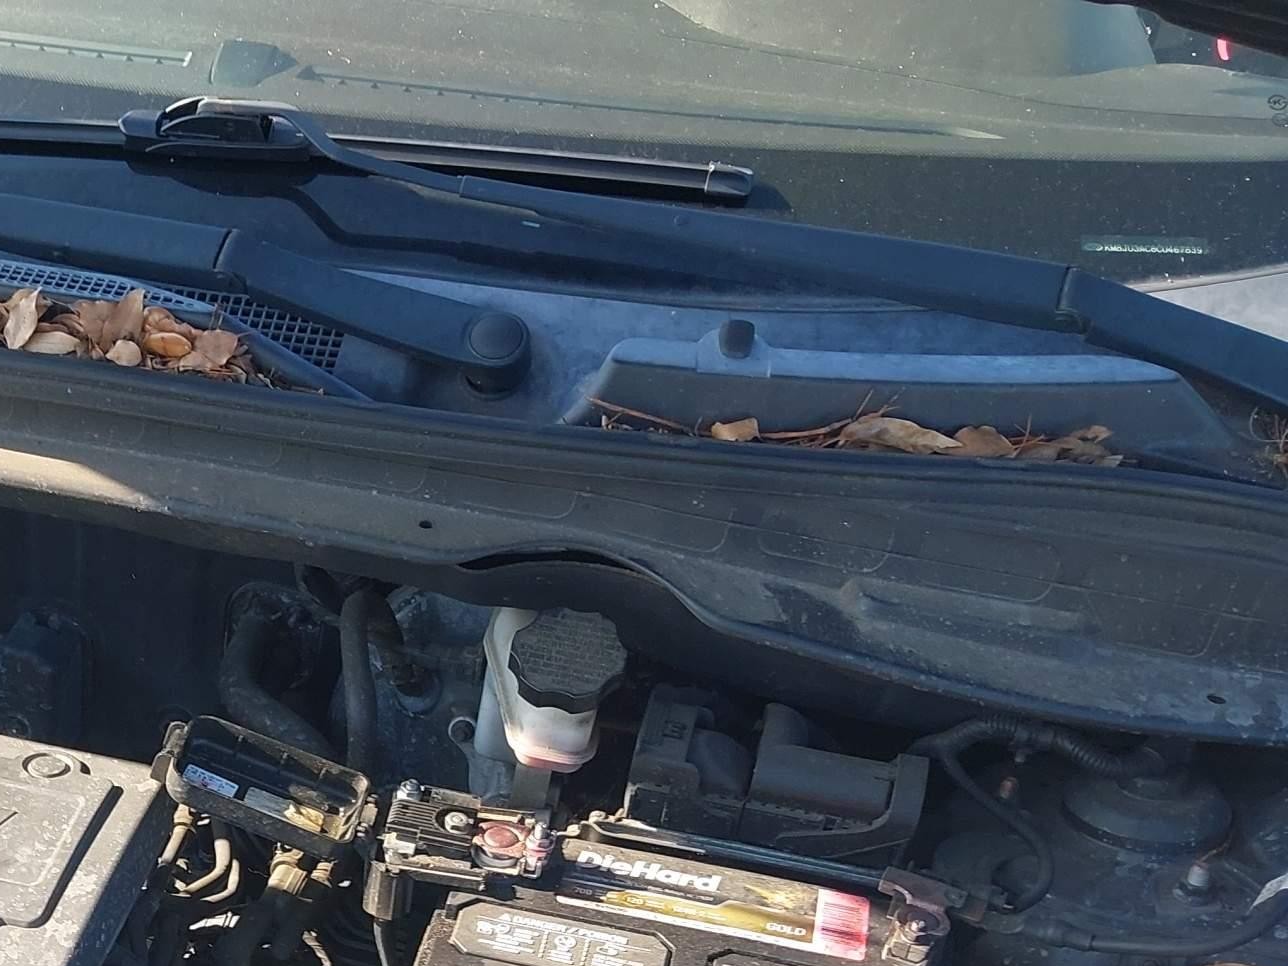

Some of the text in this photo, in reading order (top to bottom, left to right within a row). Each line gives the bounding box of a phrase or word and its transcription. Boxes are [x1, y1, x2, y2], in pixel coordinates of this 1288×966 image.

[576, 850, 722, 893] DieHard
[513, 915, 566, 933] DANGER
[765, 921, 807, 936] GOLD
